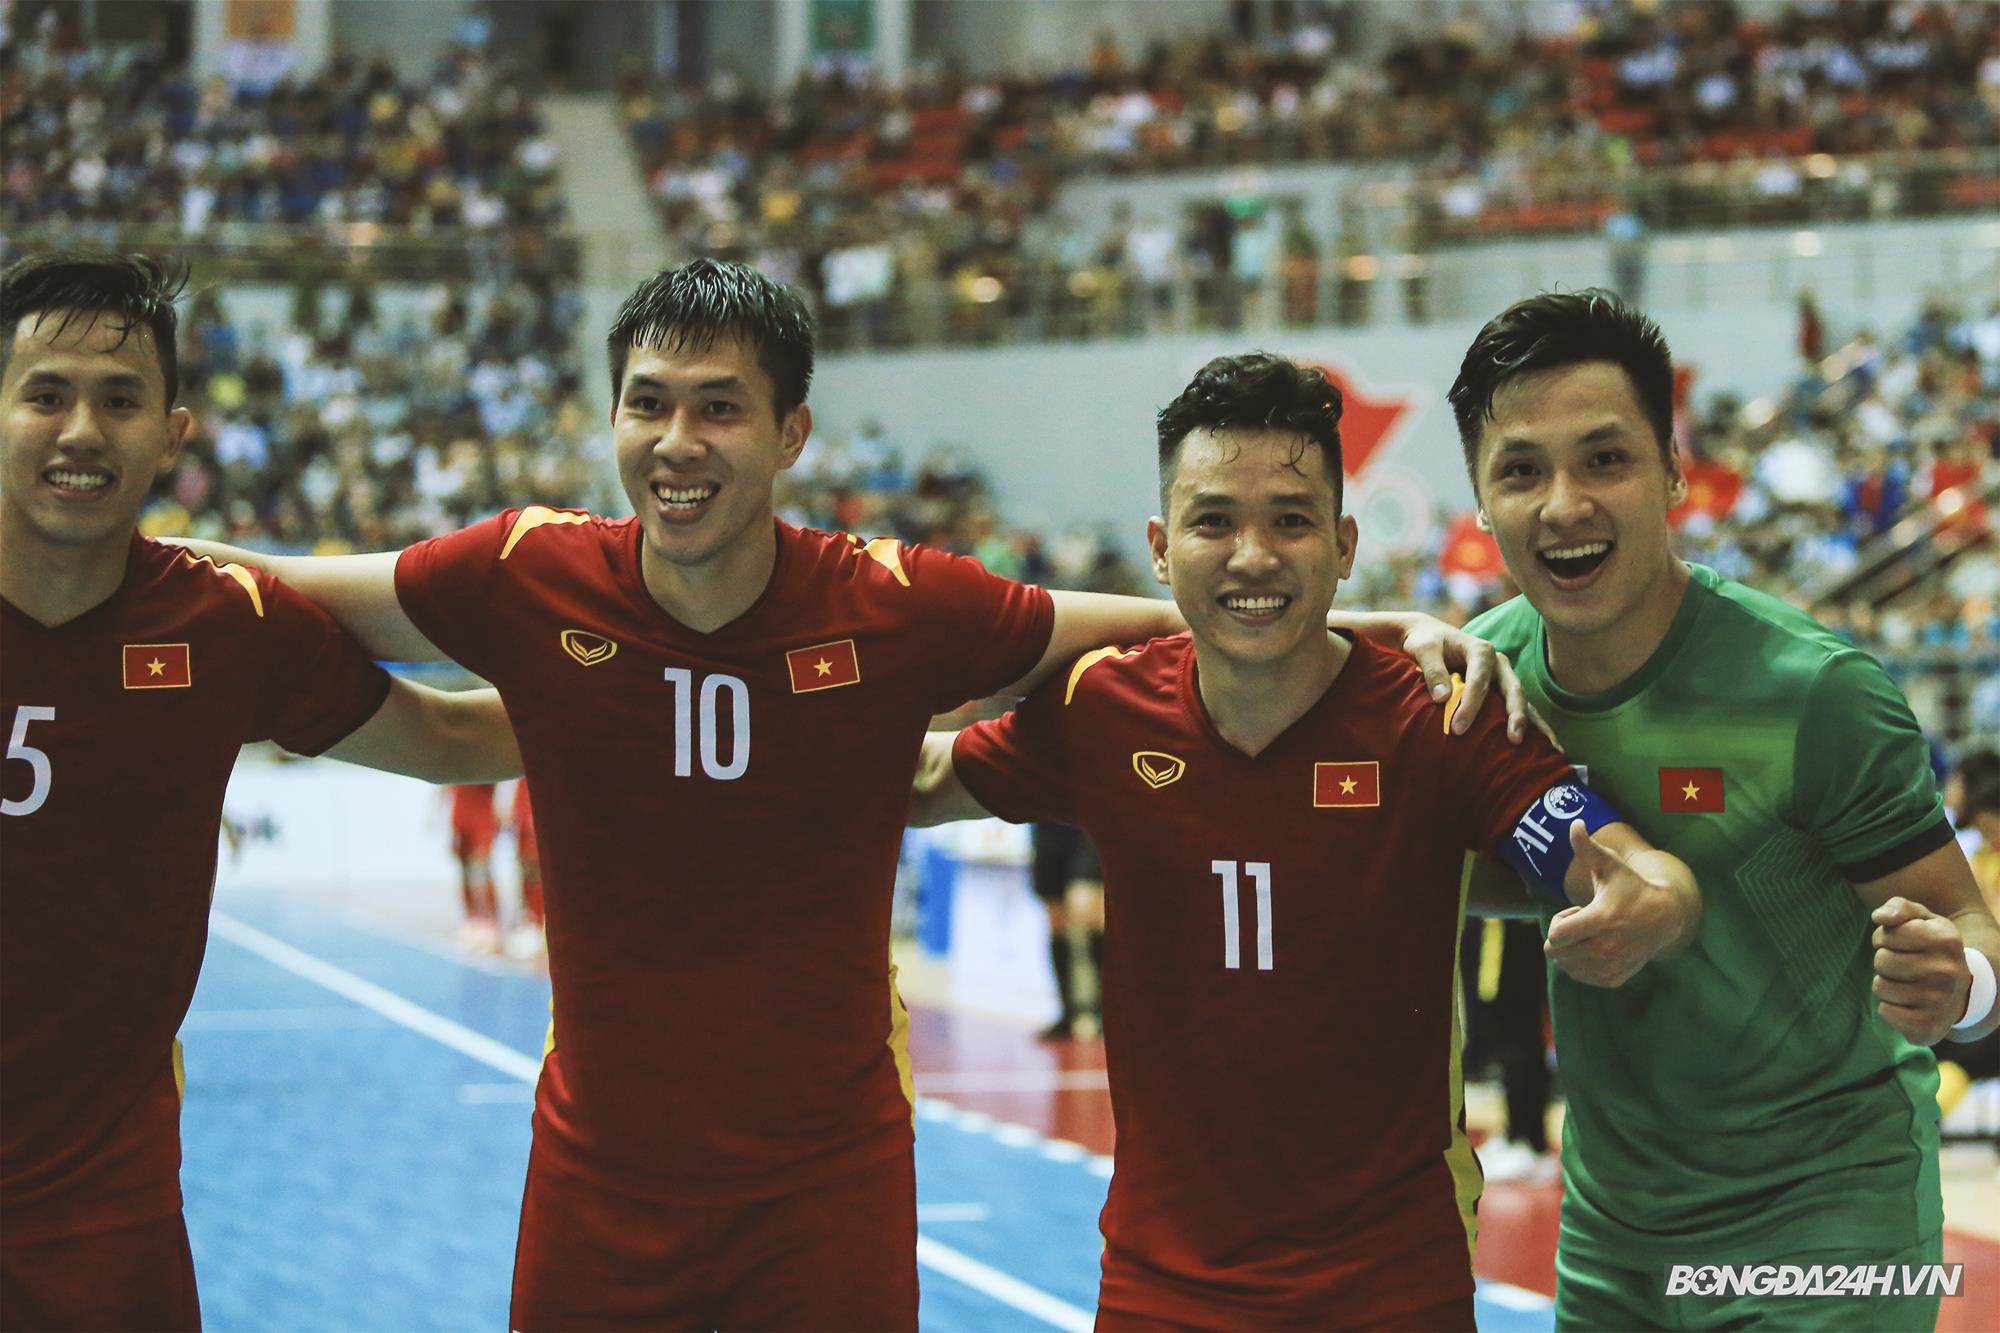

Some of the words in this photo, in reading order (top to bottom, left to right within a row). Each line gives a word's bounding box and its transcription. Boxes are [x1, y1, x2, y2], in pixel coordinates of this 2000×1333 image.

[0, 705, 56, 816] 5
[664, 667, 751, 780] 10
[1512, 784, 1588, 876] AFC
[1211, 860, 1273, 970] 11
